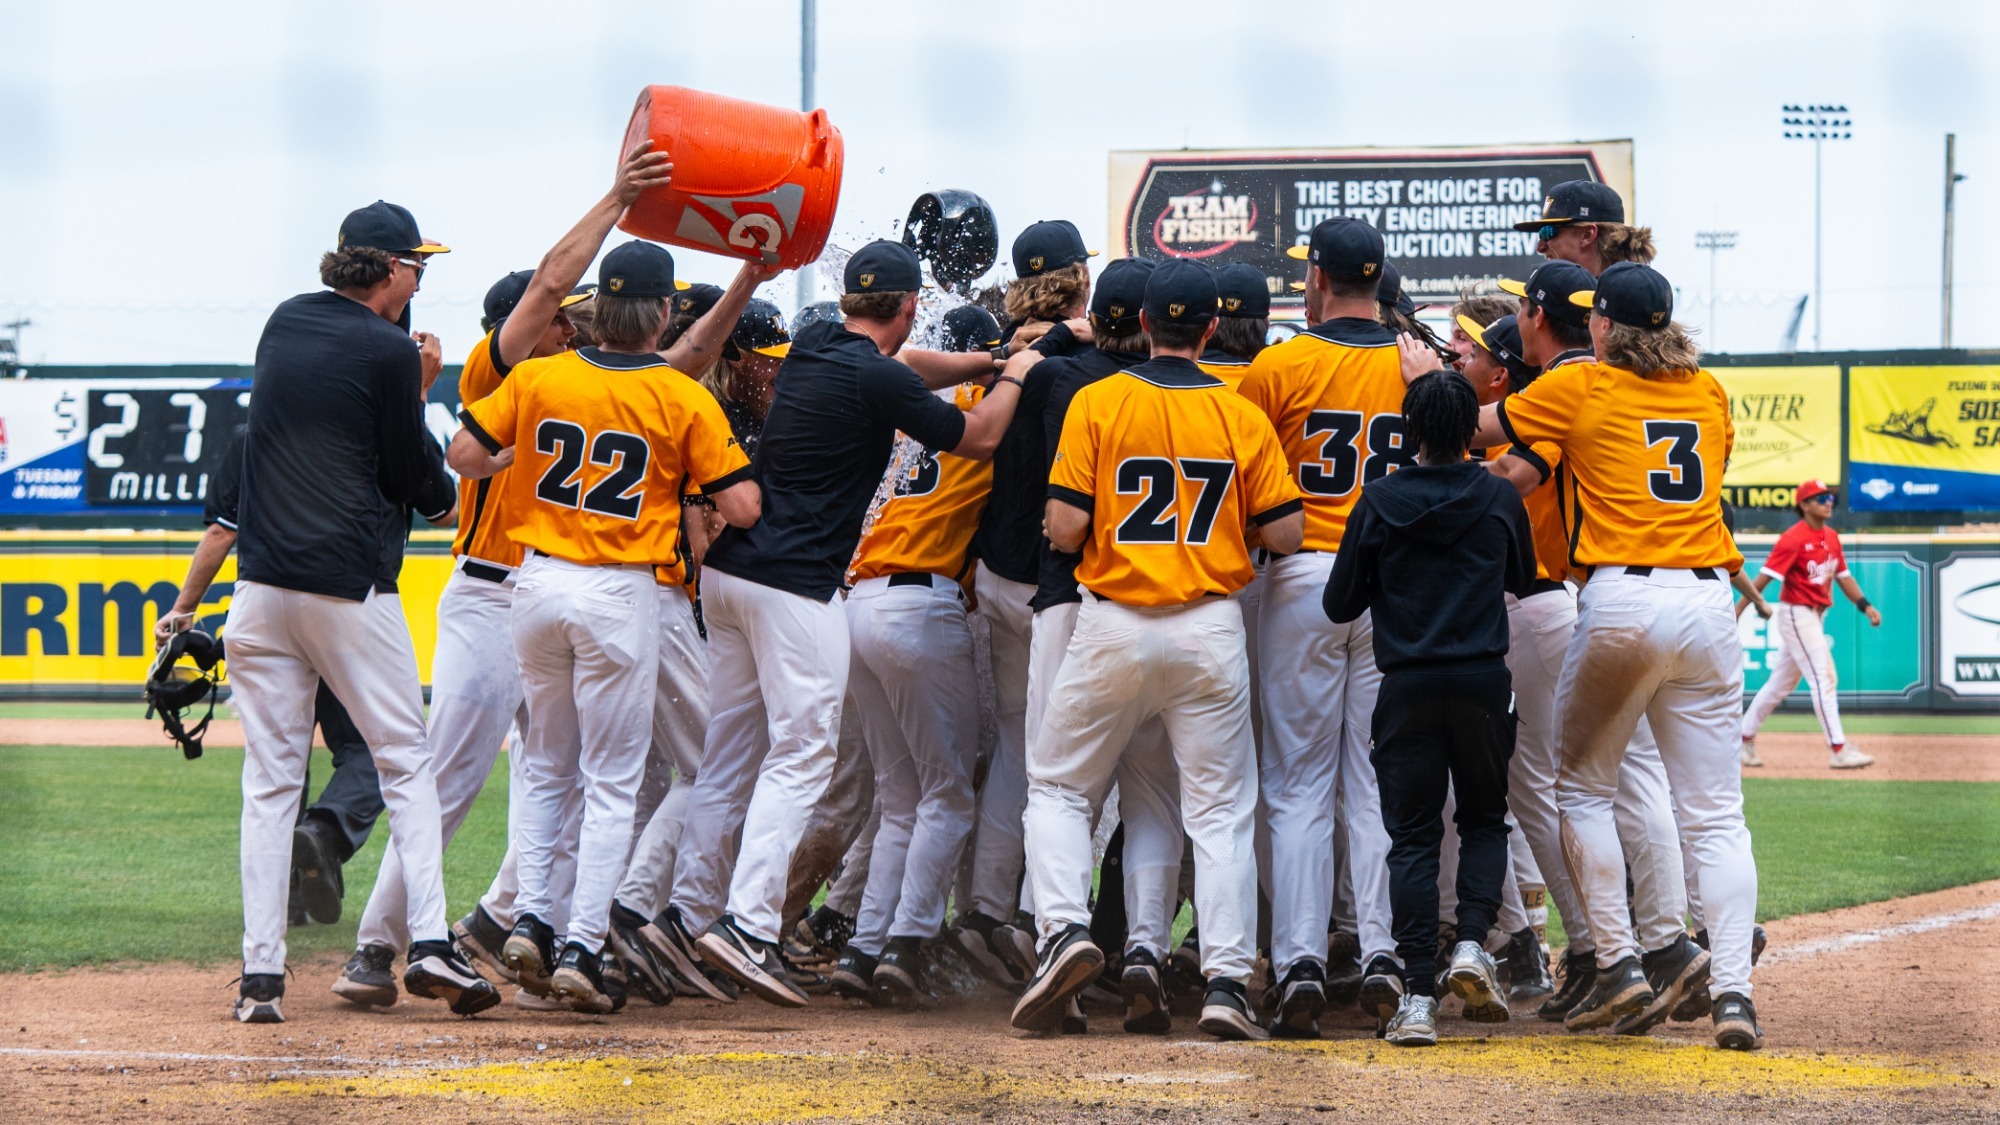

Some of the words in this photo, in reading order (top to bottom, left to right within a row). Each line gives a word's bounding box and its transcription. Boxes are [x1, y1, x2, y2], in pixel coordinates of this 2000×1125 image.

[1294, 180, 1340, 206] THE
[1344, 179, 1405, 206] BEST
[1407, 178, 1493, 205] CHOICE
[1496, 177, 1542, 203] FOR
[1168, 195, 1250, 219] TEAM
[1385, 203, 1543, 232] ENGINEERING
[1161, 218, 1258, 242] FISHEL
[1478, 230, 1540, 257] SERV
[87, 392, 251, 468] 27
[1299, 409, 1419, 497] 38
[1643, 419, 1704, 503] 3
[14, 468, 82, 484] TUESDAY
[536, 418, 650, 521] 22
[28, 484, 82, 499] FRIDAY
[1116, 456, 1235, 545] 27
